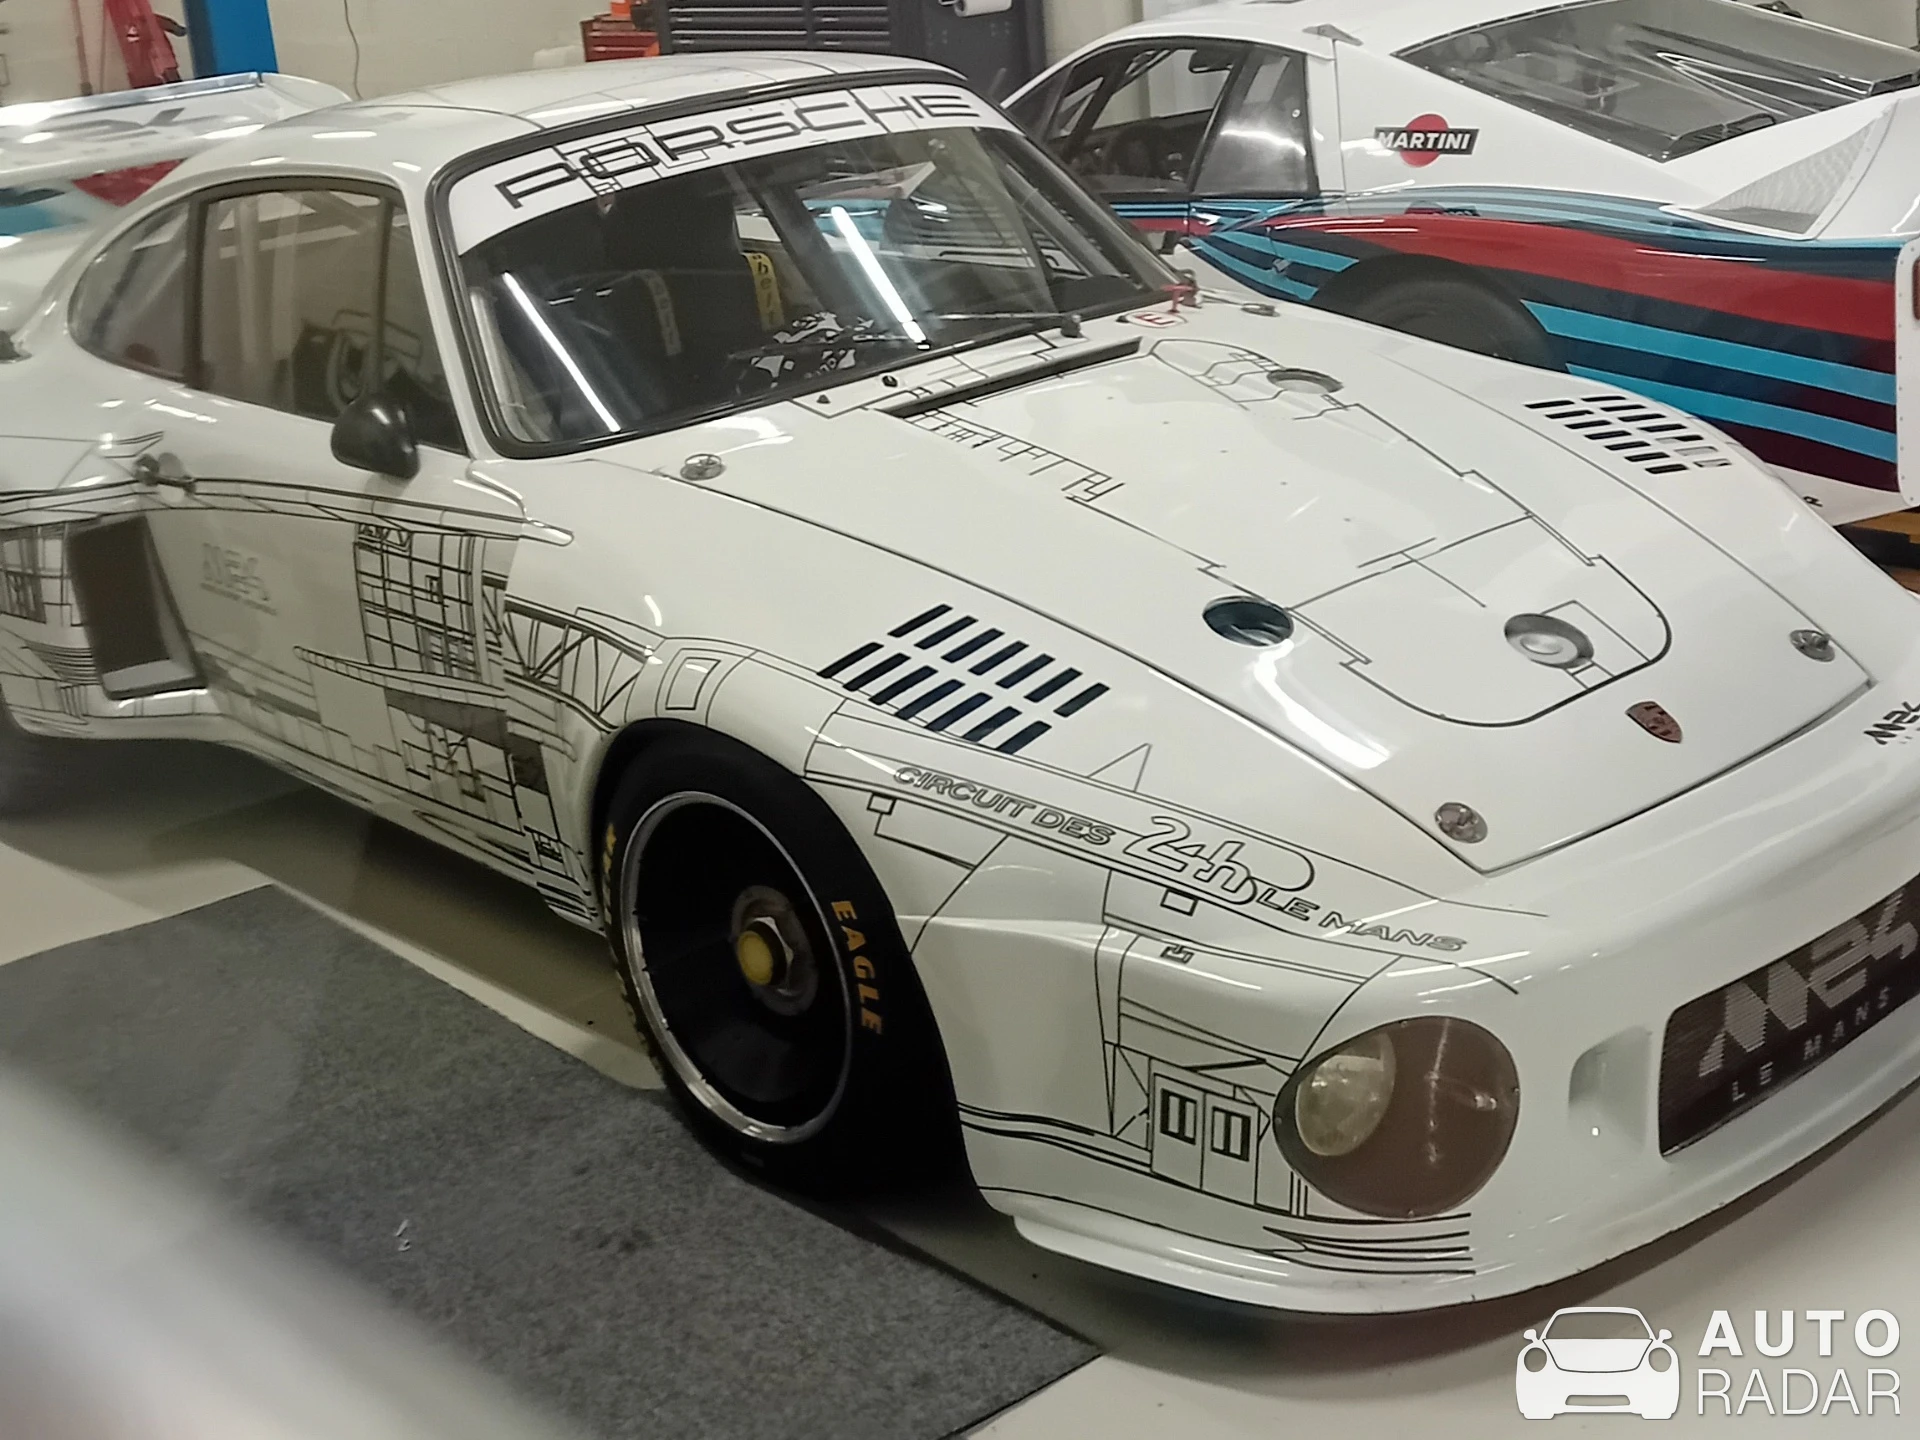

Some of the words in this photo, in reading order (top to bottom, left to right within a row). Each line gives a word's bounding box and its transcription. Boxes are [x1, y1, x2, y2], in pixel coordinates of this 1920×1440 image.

[495, 95, 983, 209] PORSCHE
[1378, 131, 1471, 150] MARTINI
[893, 766, 1037, 819] CIRCUIT
[1031, 808, 1117, 846] DES
[1255, 887, 1321, 922] LE
[1318, 911, 1468, 951] MANS
[830, 900, 883, 1035] EAGLE
[1732, 1061, 1775, 1101] LE
[1803, 985, 1891, 1061] MANS
